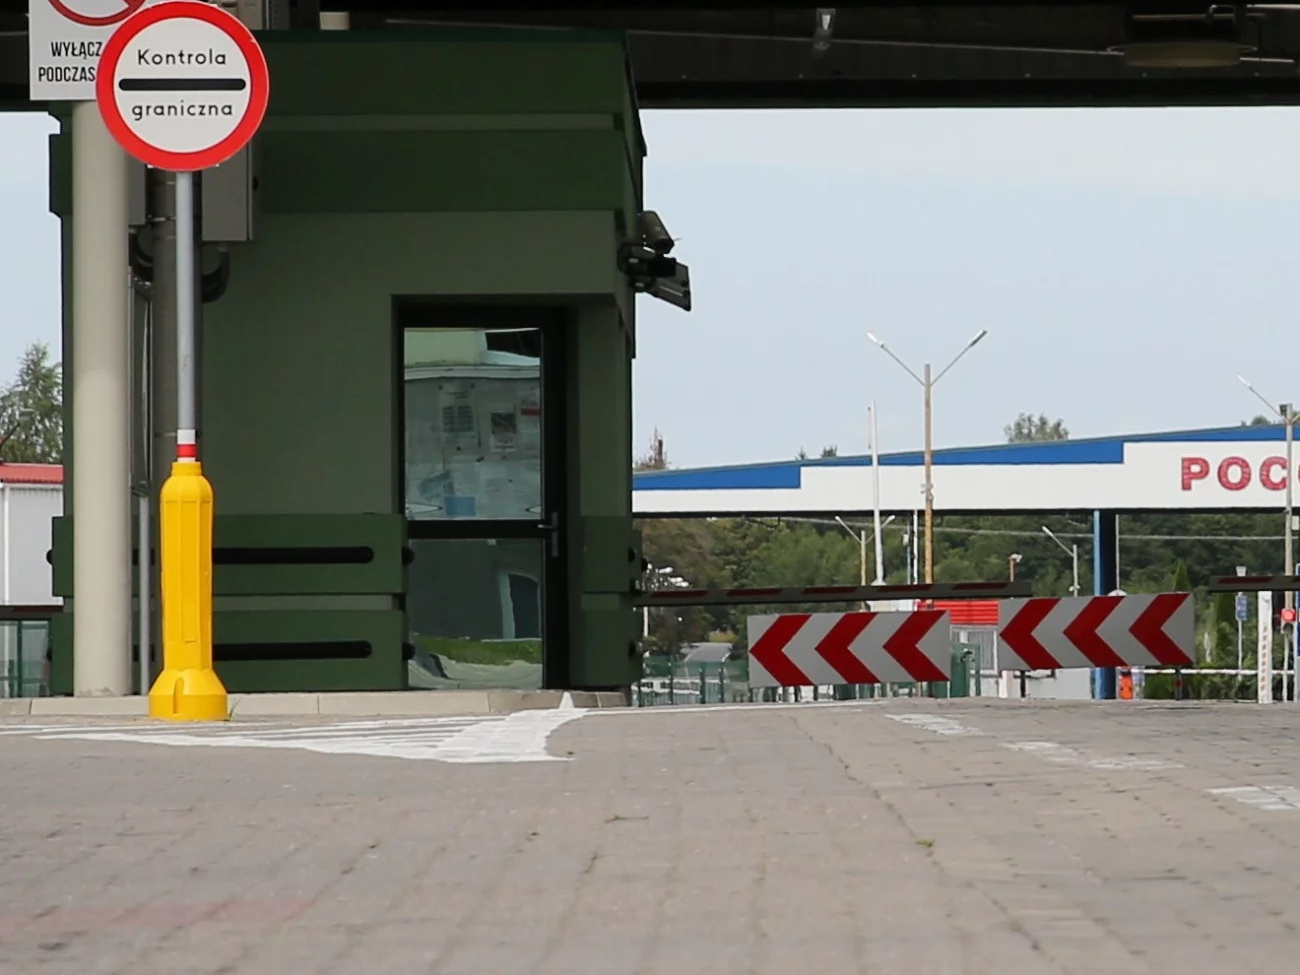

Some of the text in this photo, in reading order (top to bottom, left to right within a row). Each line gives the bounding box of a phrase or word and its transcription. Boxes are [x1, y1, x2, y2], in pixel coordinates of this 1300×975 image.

[50, 41, 102, 60] WYŁĄCZ
[137, 48, 227, 66] Kontrola
[38, 66, 96, 82] PODCZAS
[132, 100, 233, 121] graniczna
